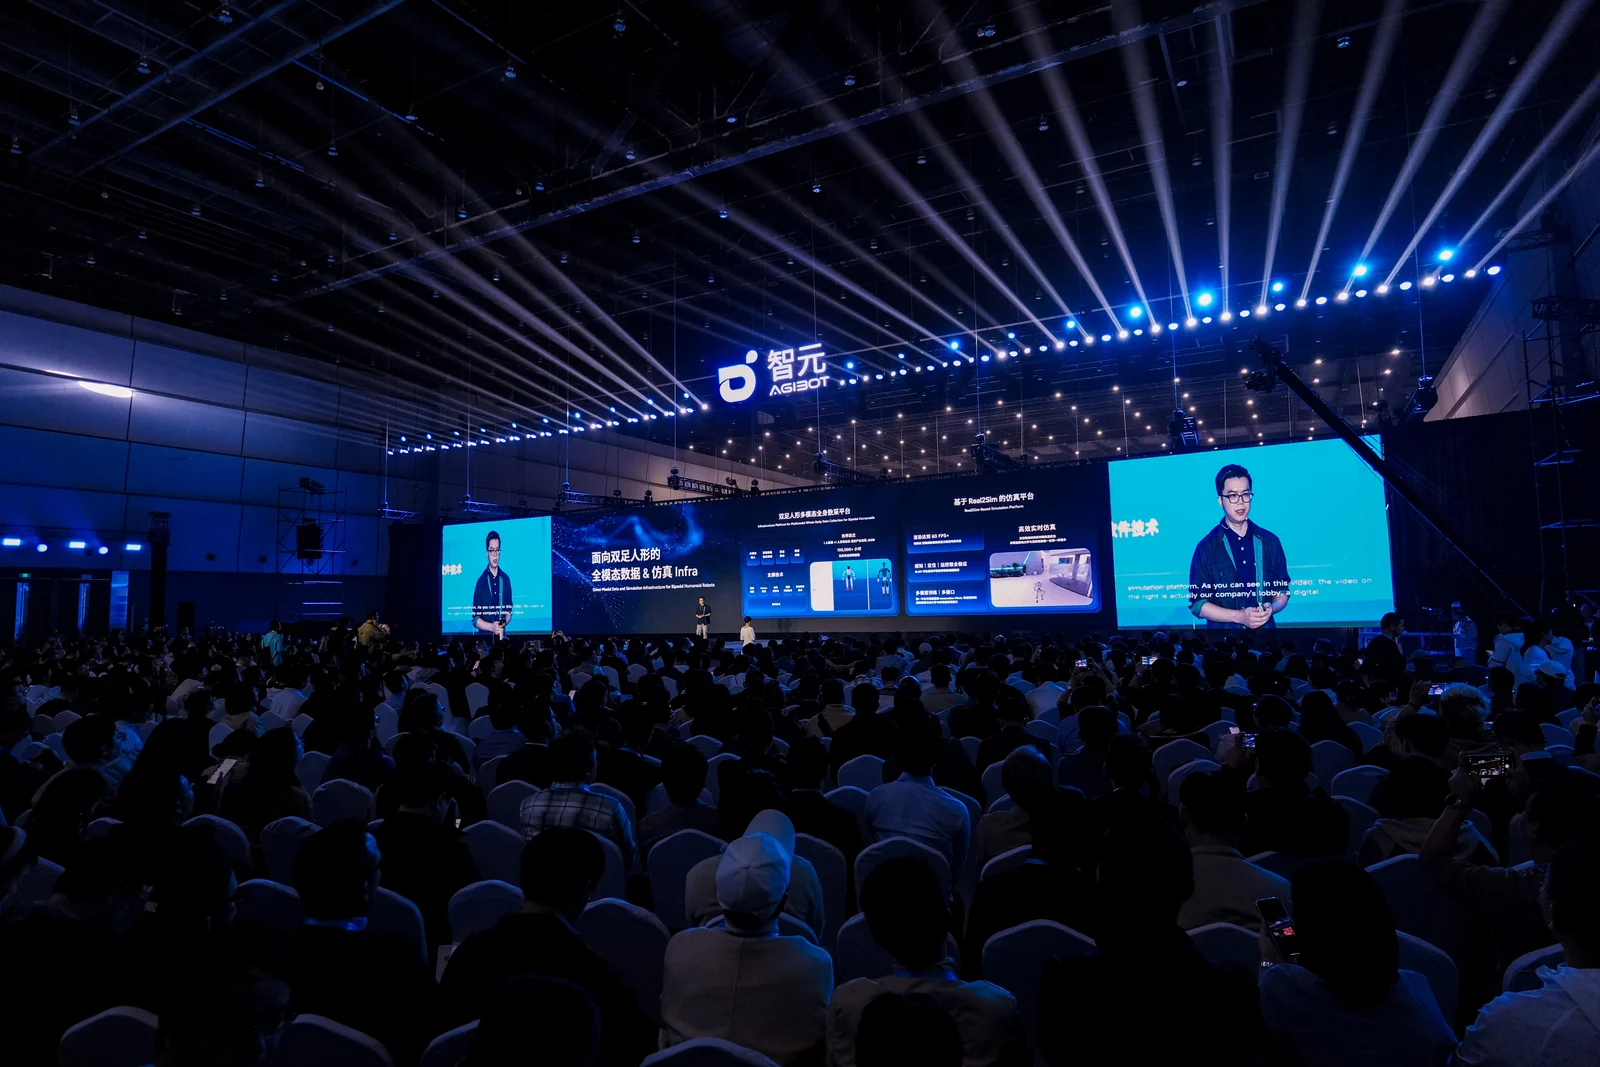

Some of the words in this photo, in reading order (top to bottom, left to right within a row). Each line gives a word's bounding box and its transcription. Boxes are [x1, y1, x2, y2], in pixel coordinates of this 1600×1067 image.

[767, 343, 826, 382] 智元
[769, 376, 830, 396] AGIBOT
[953, 498, 967, 506] 基于
[968, 496, 998, 505] Real2Sim
[998, 492, 1034, 503] 的仿真平台
[1018, 523, 1056, 533] 高效实时仿真
[591, 547, 661, 565] 面向双足人形的
[591, 567, 641, 582] 全模态数据
[642, 568, 650, 579] &
[652, 565, 673, 580] 仿真
[675, 565, 698, 578] Infra
[1128, 584, 1164, 592] simulation
[1166, 582, 1199, 591] platform.
[1142, 593, 1159, 601] right
[1170, 591, 1198, 600] actually
[1215, 590, 1257, 599] company's
[1293, 588, 1319, 597] digital
